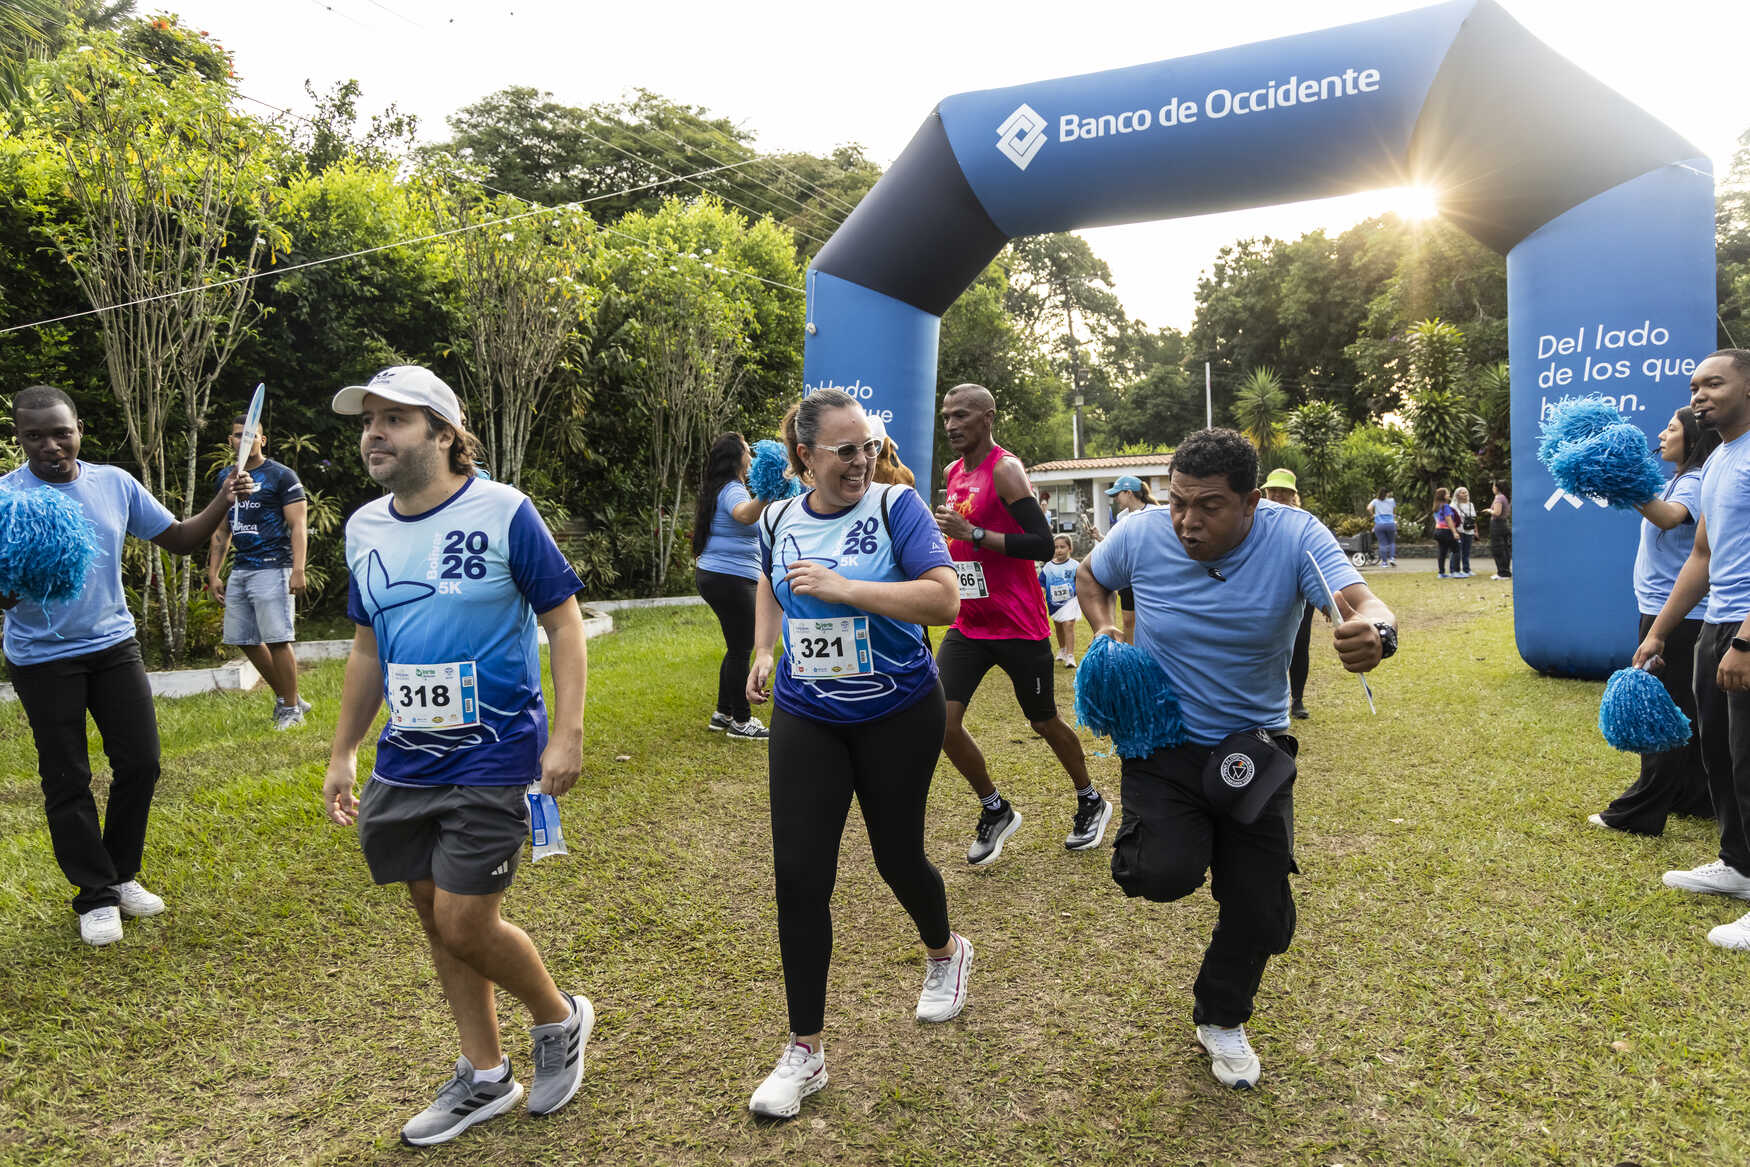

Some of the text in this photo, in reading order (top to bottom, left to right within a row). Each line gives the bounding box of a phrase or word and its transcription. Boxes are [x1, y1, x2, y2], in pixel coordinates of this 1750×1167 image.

[1059, 68, 1380, 142] Banco de Occidente
[1537, 320, 1669, 359] Del lado
[1538, 356, 1695, 388] de los que
[1540, 393, 1646, 420] hen.
[846, 516, 879, 538] 20
[443, 530, 489, 555] 20
[843, 535, 878, 555] 26
[440, 554, 487, 580] 26
[840, 556, 859, 567] 5K
[438, 581, 463, 595] 5K
[956, 573, 975, 586] 66
[800, 636, 844, 658] 321
[399, 685, 450, 708] 318
